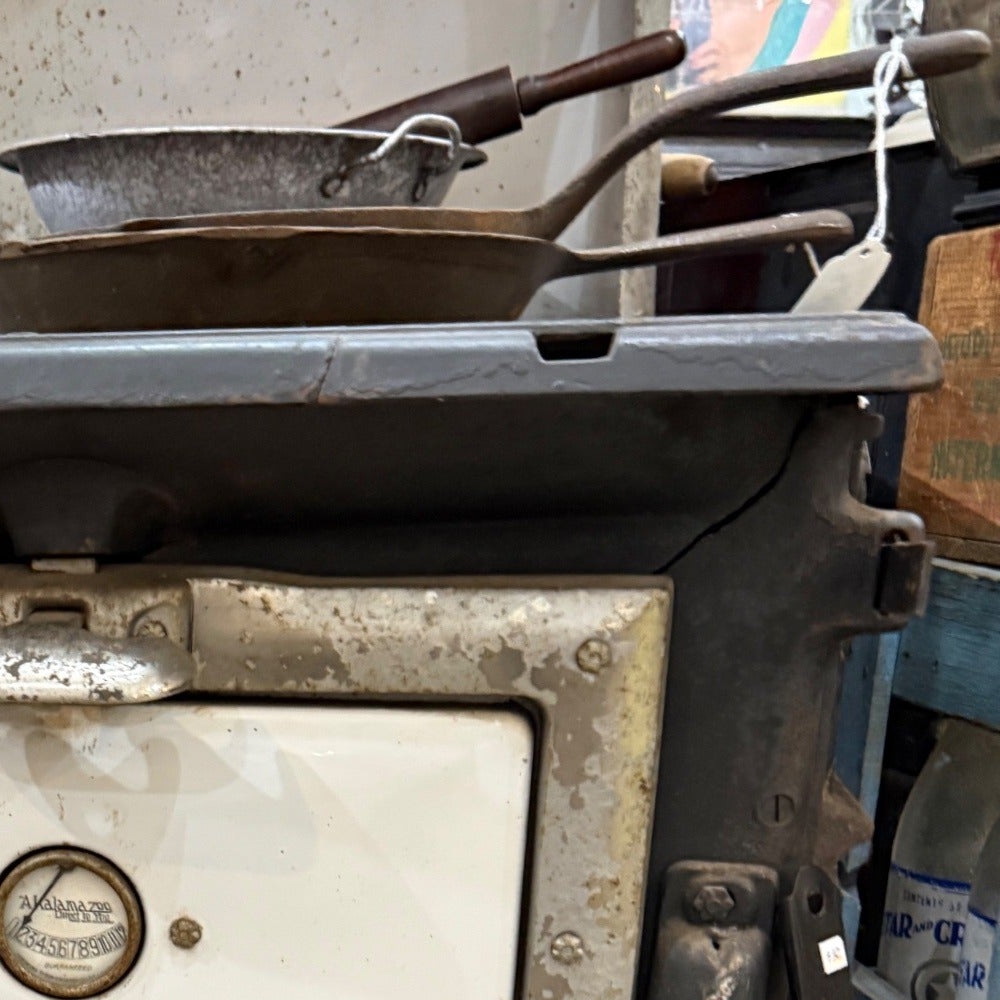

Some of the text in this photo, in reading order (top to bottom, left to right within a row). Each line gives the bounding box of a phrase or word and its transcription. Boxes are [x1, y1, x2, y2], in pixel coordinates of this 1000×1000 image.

[884, 911, 913, 939] TAR
[934, 919, 966, 946] CR
[48, 940, 58, 957] 5
[59, 940, 67, 958] 6
[68, 940, 77, 959] 7
[79, 940, 90, 958] 8
[90, 938, 100, 956] 9
[957, 960, 986, 990] AR
